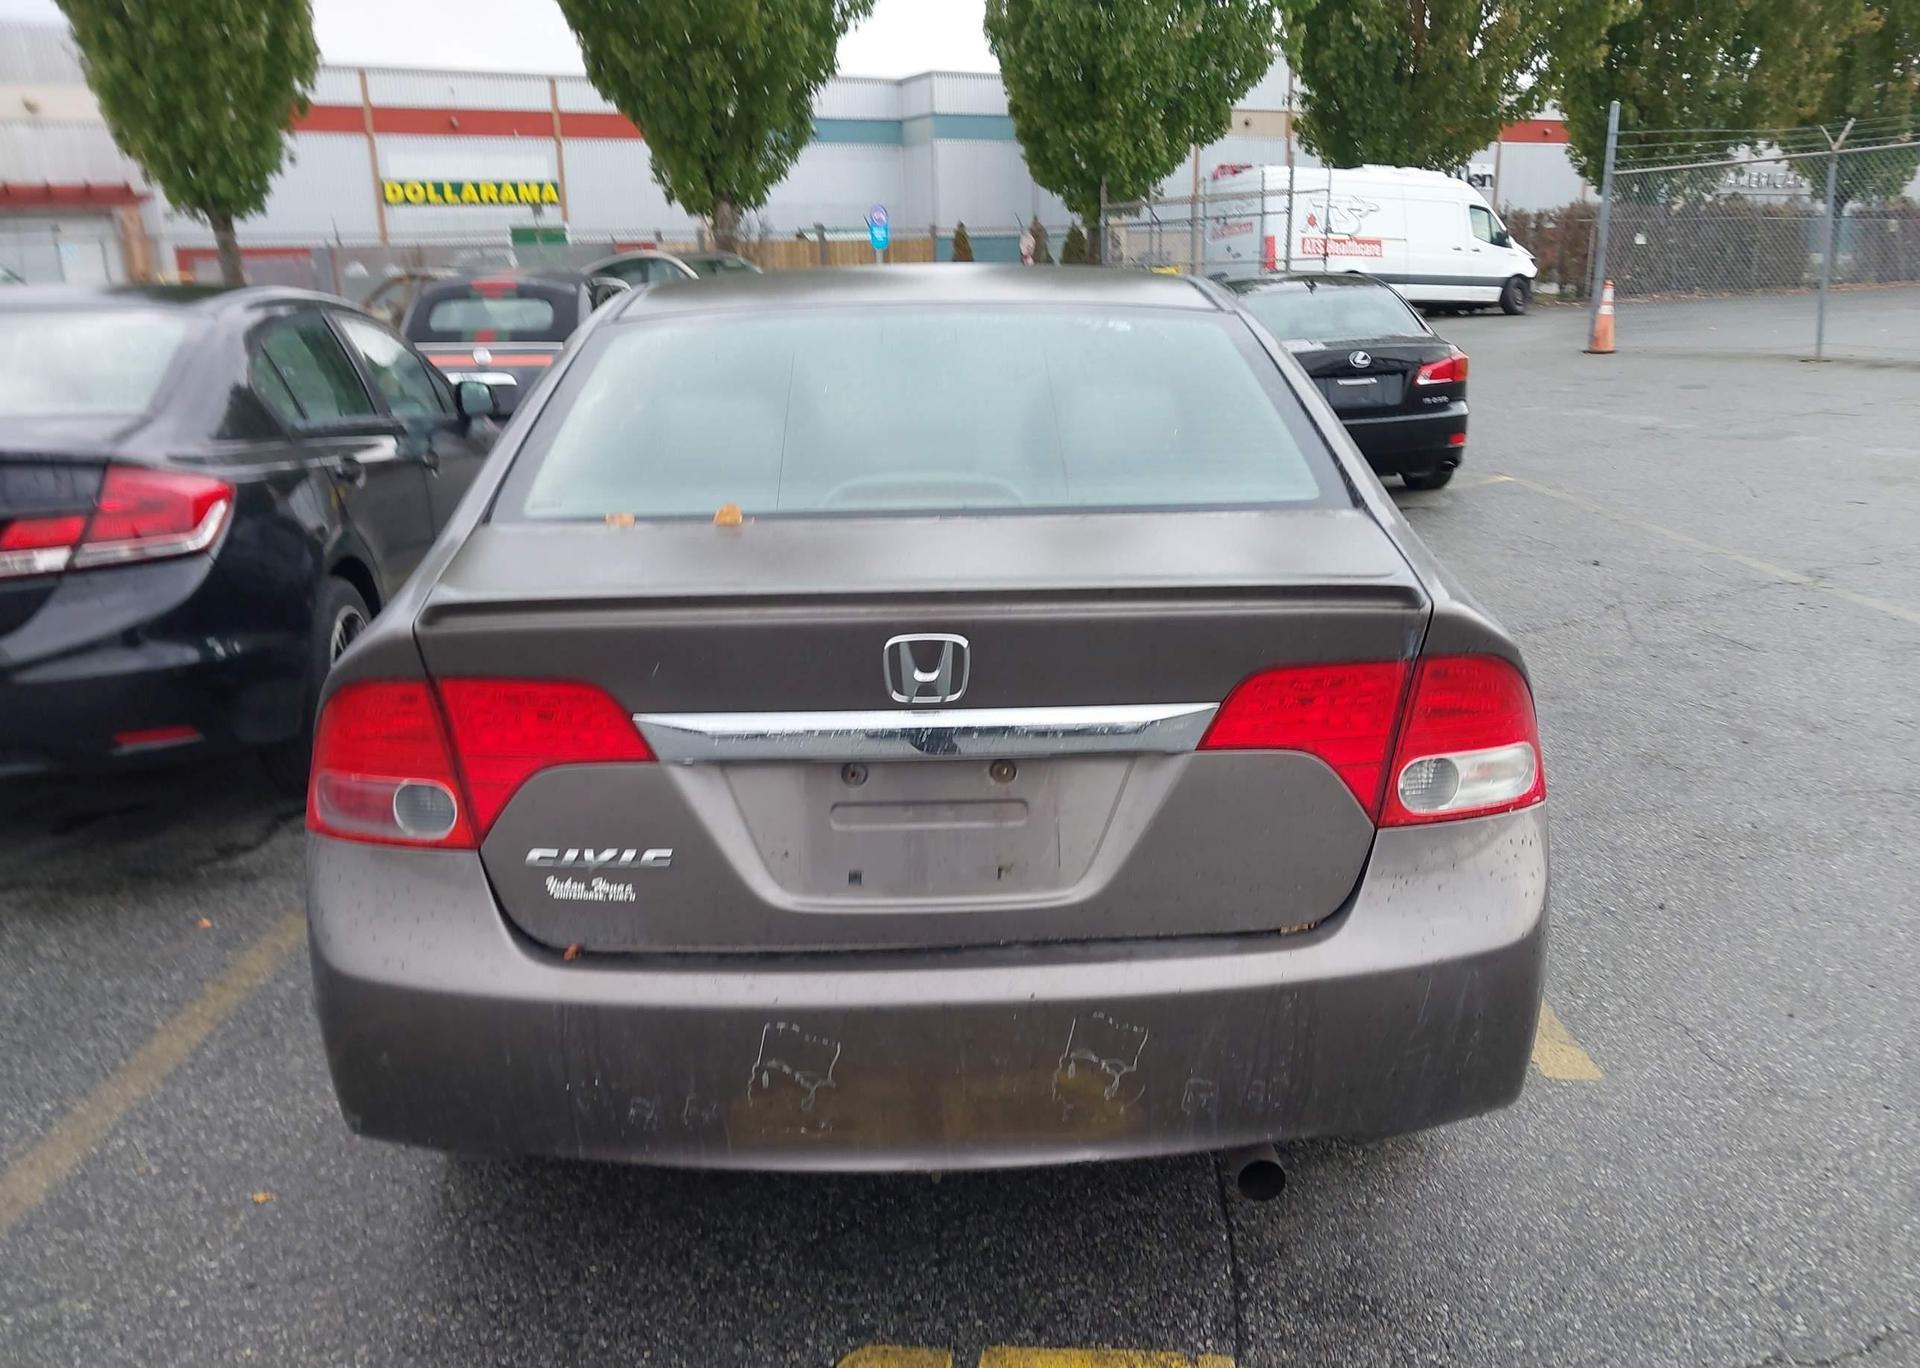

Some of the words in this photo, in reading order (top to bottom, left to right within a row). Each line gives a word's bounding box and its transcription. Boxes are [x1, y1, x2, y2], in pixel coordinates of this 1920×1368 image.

[383, 180, 560, 205] DOLLARAMA
[1303, 238, 1326, 254] ATS
[525, 848, 673, 871] CIVIC
